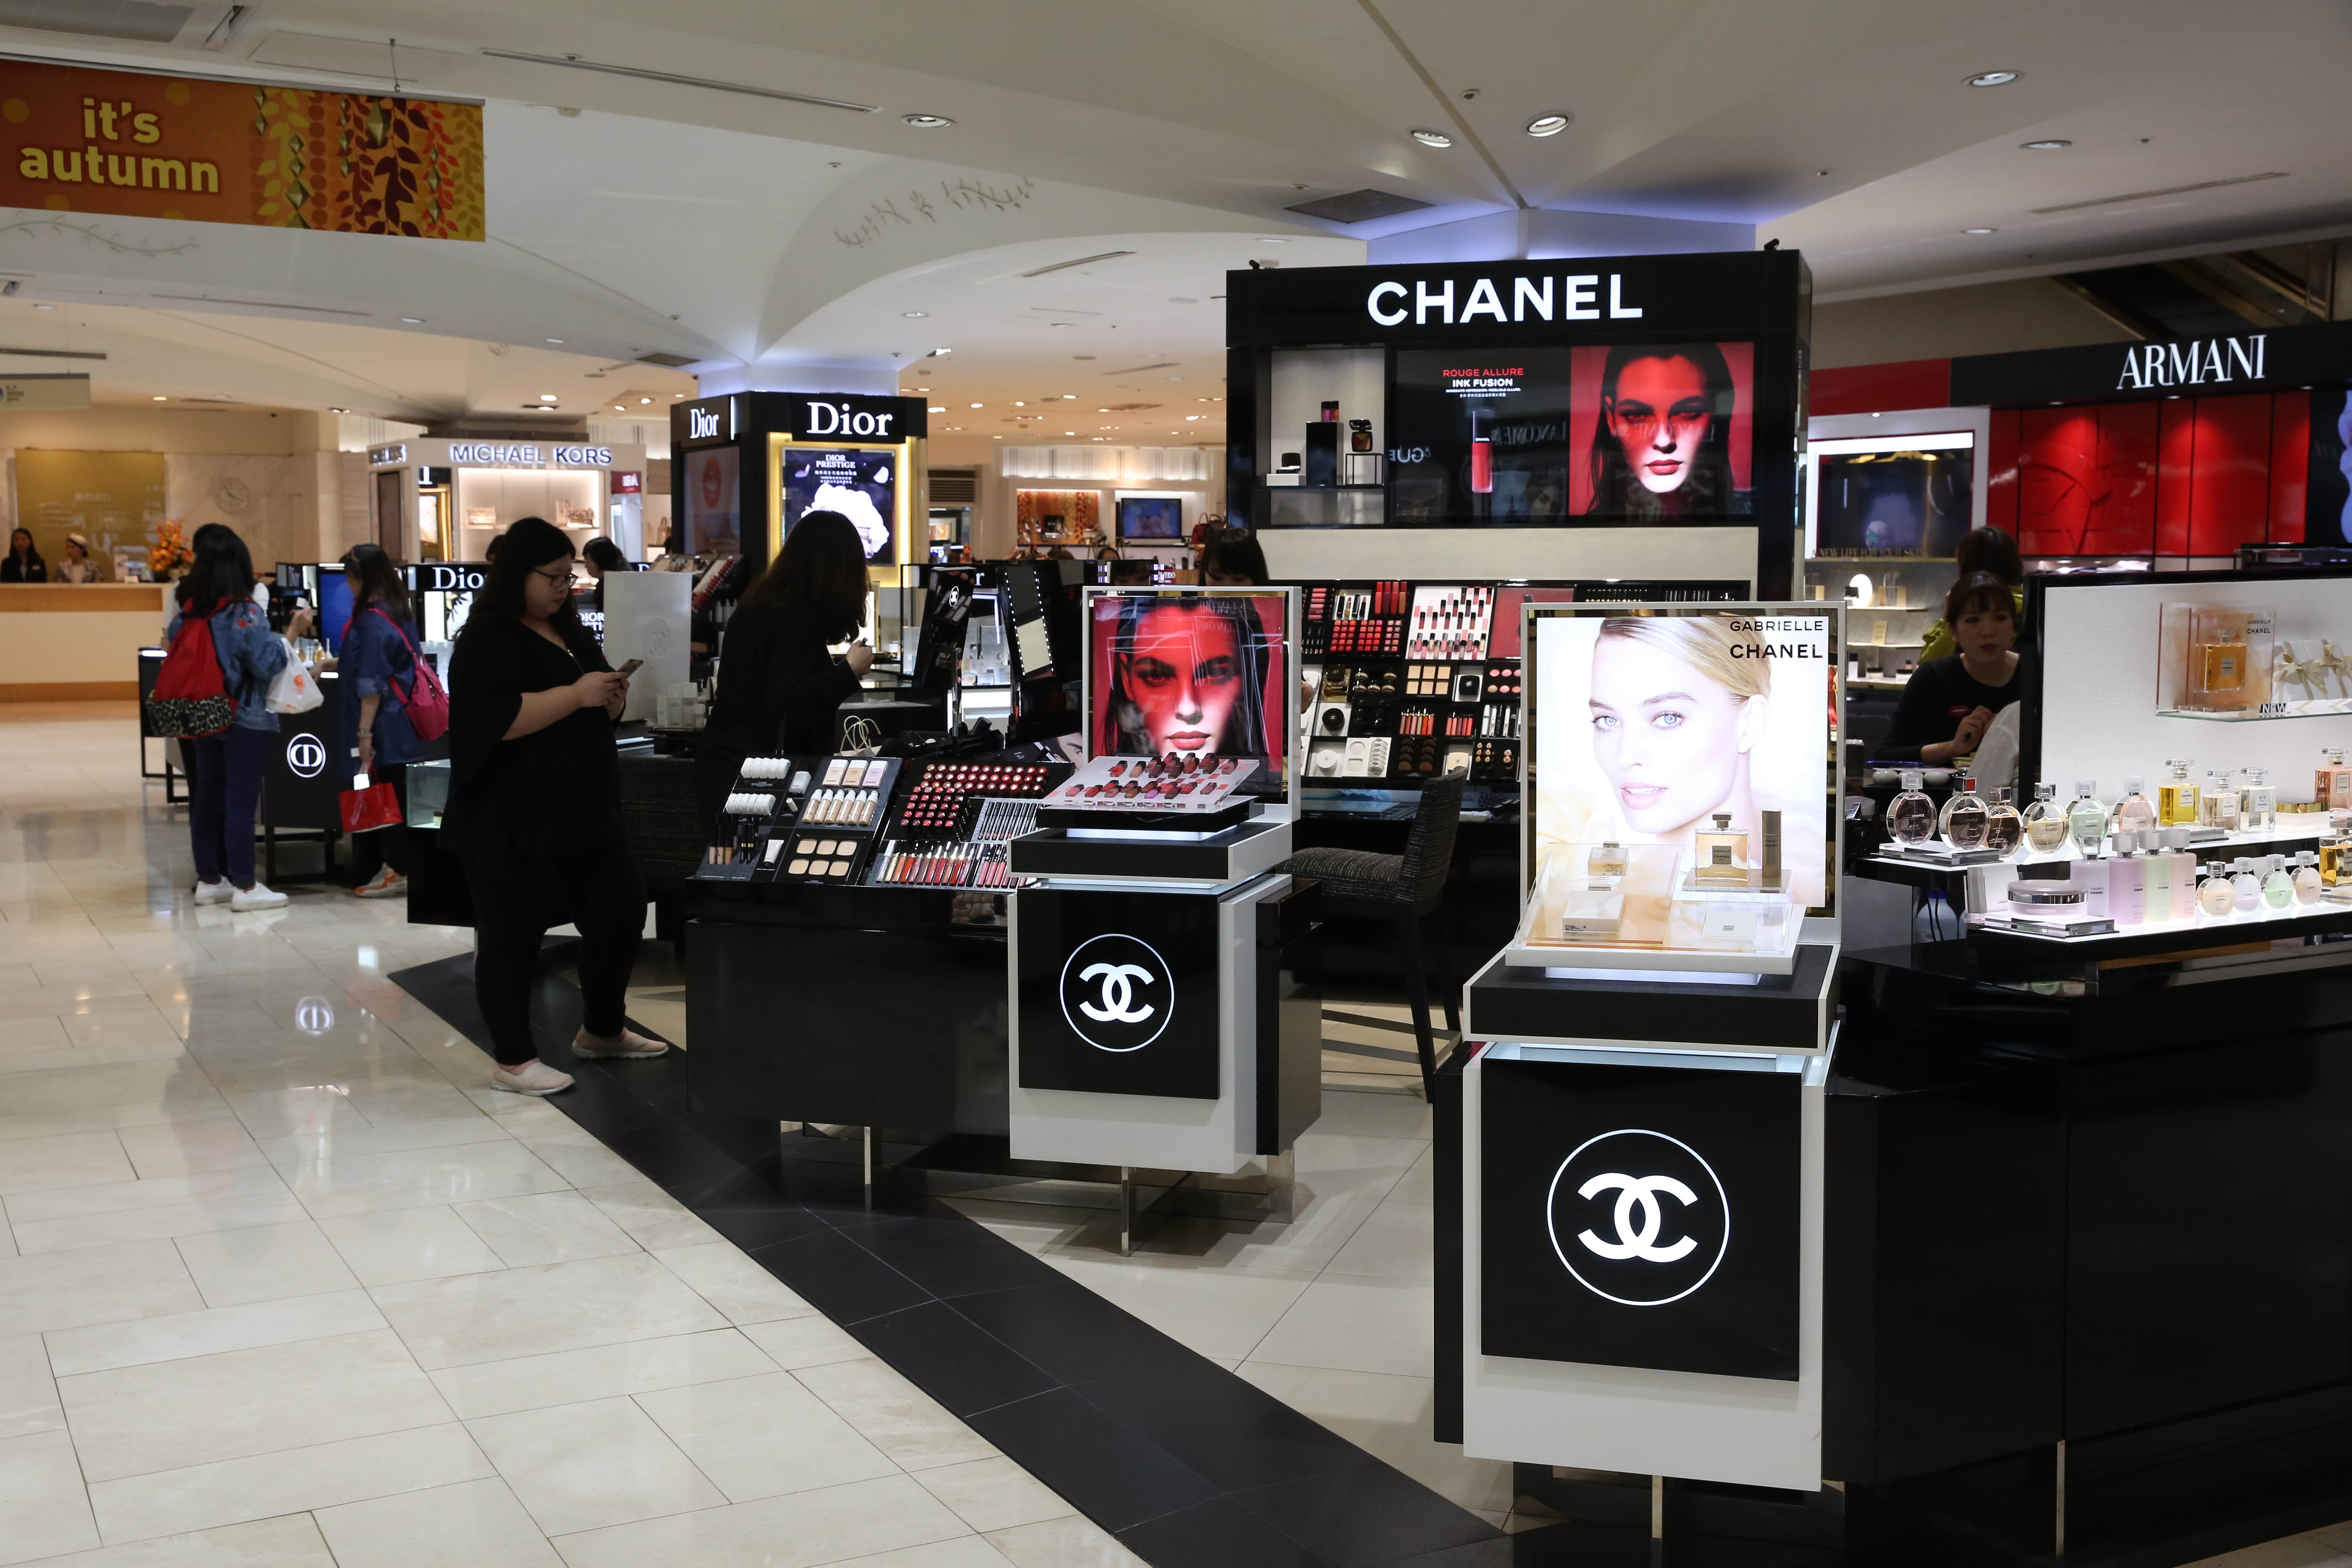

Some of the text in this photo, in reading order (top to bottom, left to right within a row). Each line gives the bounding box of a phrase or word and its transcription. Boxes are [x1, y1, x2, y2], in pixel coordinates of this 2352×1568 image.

[83, 98, 161, 143] it's
[19, 144, 220, 193] autumn
[1367, 274, 1644, 327] CHANEL
[1482, 368, 1523, 376] ALLURE
[2116, 334, 2267, 390] ARMANI
[1452, 378, 1513, 388] INK FUSION
[689, 407, 720, 439] Dior
[806, 402, 893, 436] Dior
[450, 444, 612, 466] MICHAEL KORS
[815, 460, 856, 469] PRESTIGE
[825, 454, 846, 462] DIOR
[432, 567, 488, 589] Dio
[1729, 620, 1824, 632] GABRIELLE
[1729, 643, 1823, 659] CHANEL
